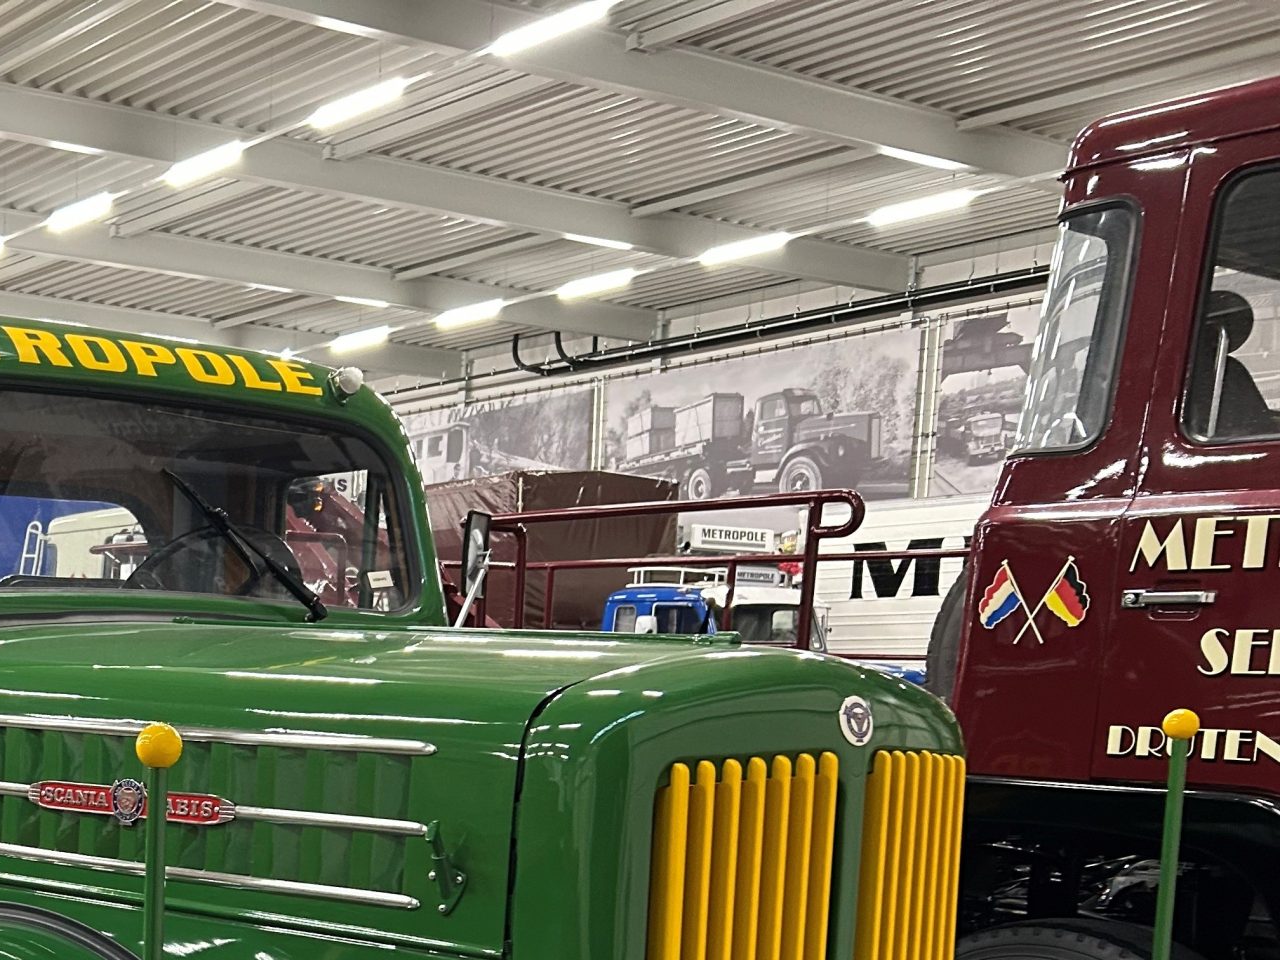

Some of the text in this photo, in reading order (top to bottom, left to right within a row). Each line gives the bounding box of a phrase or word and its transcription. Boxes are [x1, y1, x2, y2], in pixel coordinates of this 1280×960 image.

[701, 527, 767, 543] METROPOLE
[1129, 515, 1280, 573] MET
[736, 571, 775, 581] METROPOLE
[42, 786, 109, 808] SCANIA
